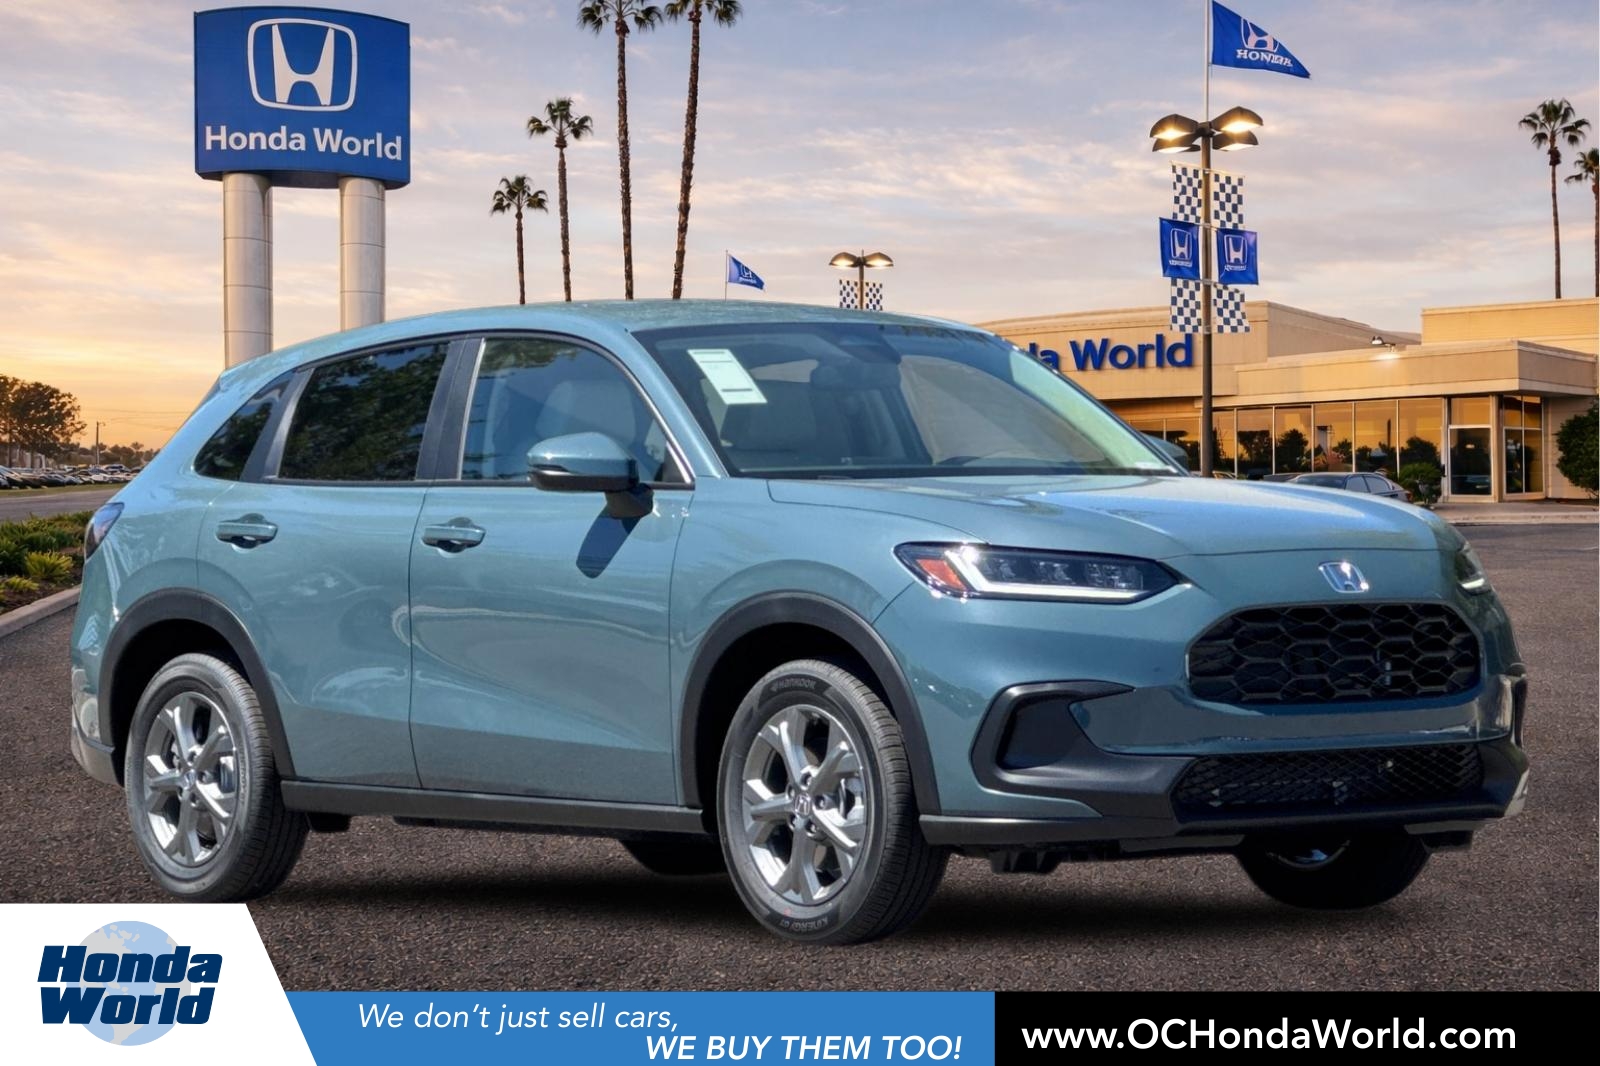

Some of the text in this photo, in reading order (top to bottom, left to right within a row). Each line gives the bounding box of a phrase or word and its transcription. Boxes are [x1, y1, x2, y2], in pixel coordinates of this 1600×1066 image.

[205, 125, 402, 161] Honda World
[1069, 333, 1194, 371] World
